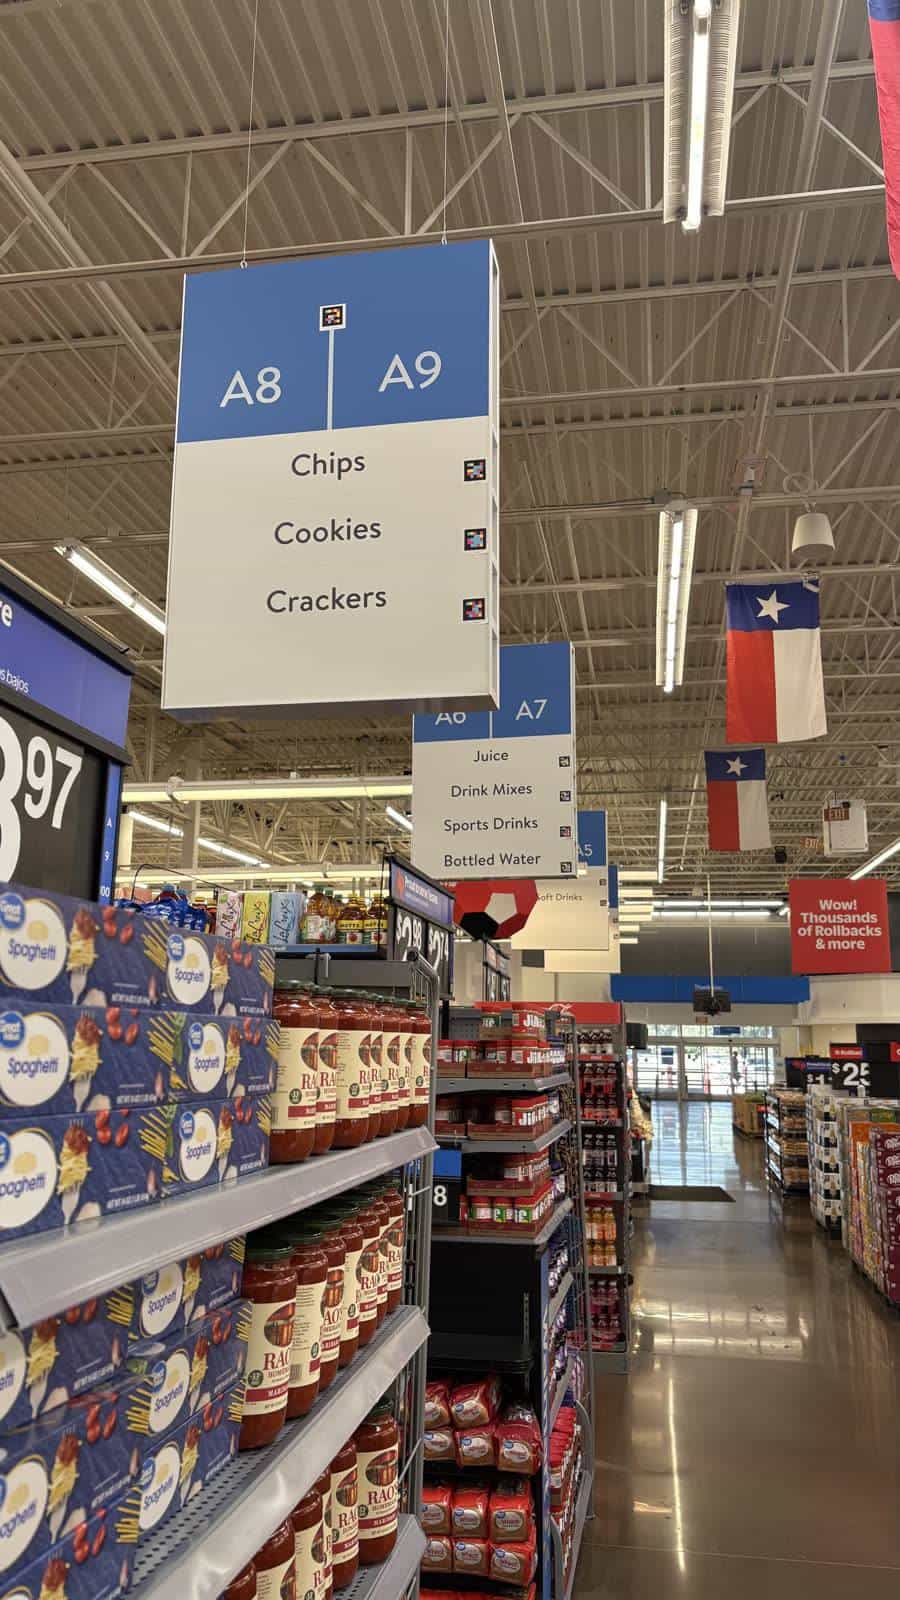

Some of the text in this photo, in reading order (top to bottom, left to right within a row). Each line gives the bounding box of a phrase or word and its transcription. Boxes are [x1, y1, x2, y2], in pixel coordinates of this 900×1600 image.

[219, 350, 442, 408] A8 A9
[291, 451, 366, 480] Chips
[273, 517, 382, 545] Cookies
[266, 587, 387, 614] Crackers
[7, 668, 29, 693] bajos
[515, 698, 548, 721] A7
[473, 750, 509, 763] Juice
[451, 784, 532, 798] Drink Mixes
[443, 817, 538, 835] Sports Drinks
[443, 853, 541, 868] Bottled Water
[556, 893, 583, 901] Drinks
[819, 899, 858, 911] Wow!
[800, 911, 878, 924] Thousands
[797, 924, 882, 937] of Rollbacks
[8, 938, 56, 962] Spaghetti
[815, 939, 865, 950] & more
[175, 967, 205, 984] Spaghetti
[8, 1058, 59, 1078] Spaghetti
[194, 1055, 220, 1072] Spaghetti
[186, 1142, 211, 1160] Spaghetti
